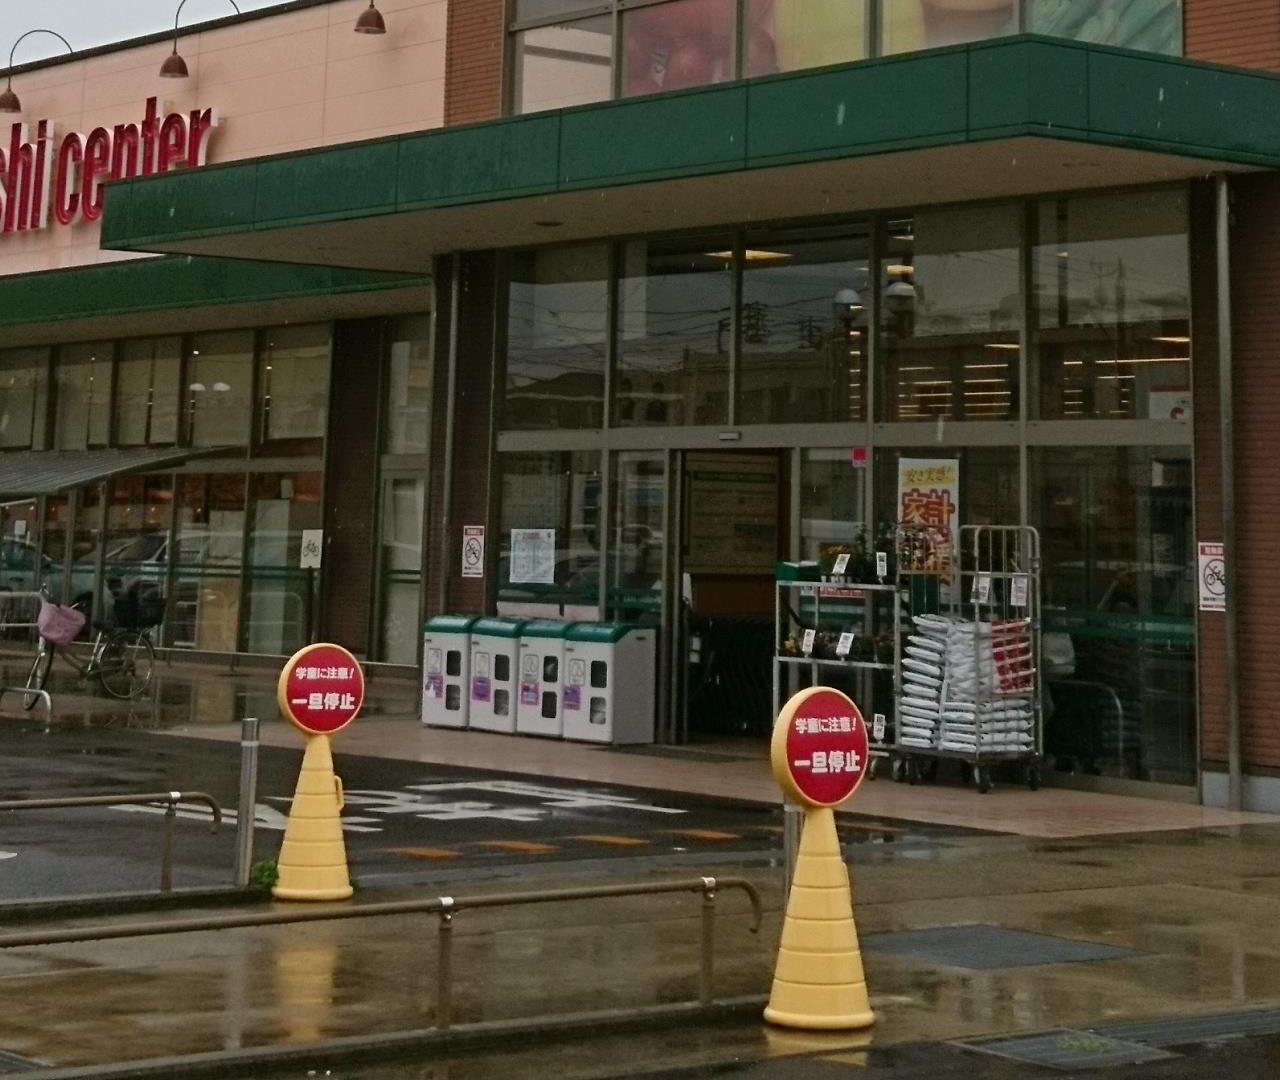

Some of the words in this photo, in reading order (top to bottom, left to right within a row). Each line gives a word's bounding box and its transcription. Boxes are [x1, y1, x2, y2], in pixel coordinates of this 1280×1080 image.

[54, 96, 218, 226] center
[295, 666, 355, 680] 学童に注意!
[291, 692, 356, 711] 一旦停止
[795, 716, 857, 735] 学童に注意!
[793, 749, 861, 774] 一旦停止
